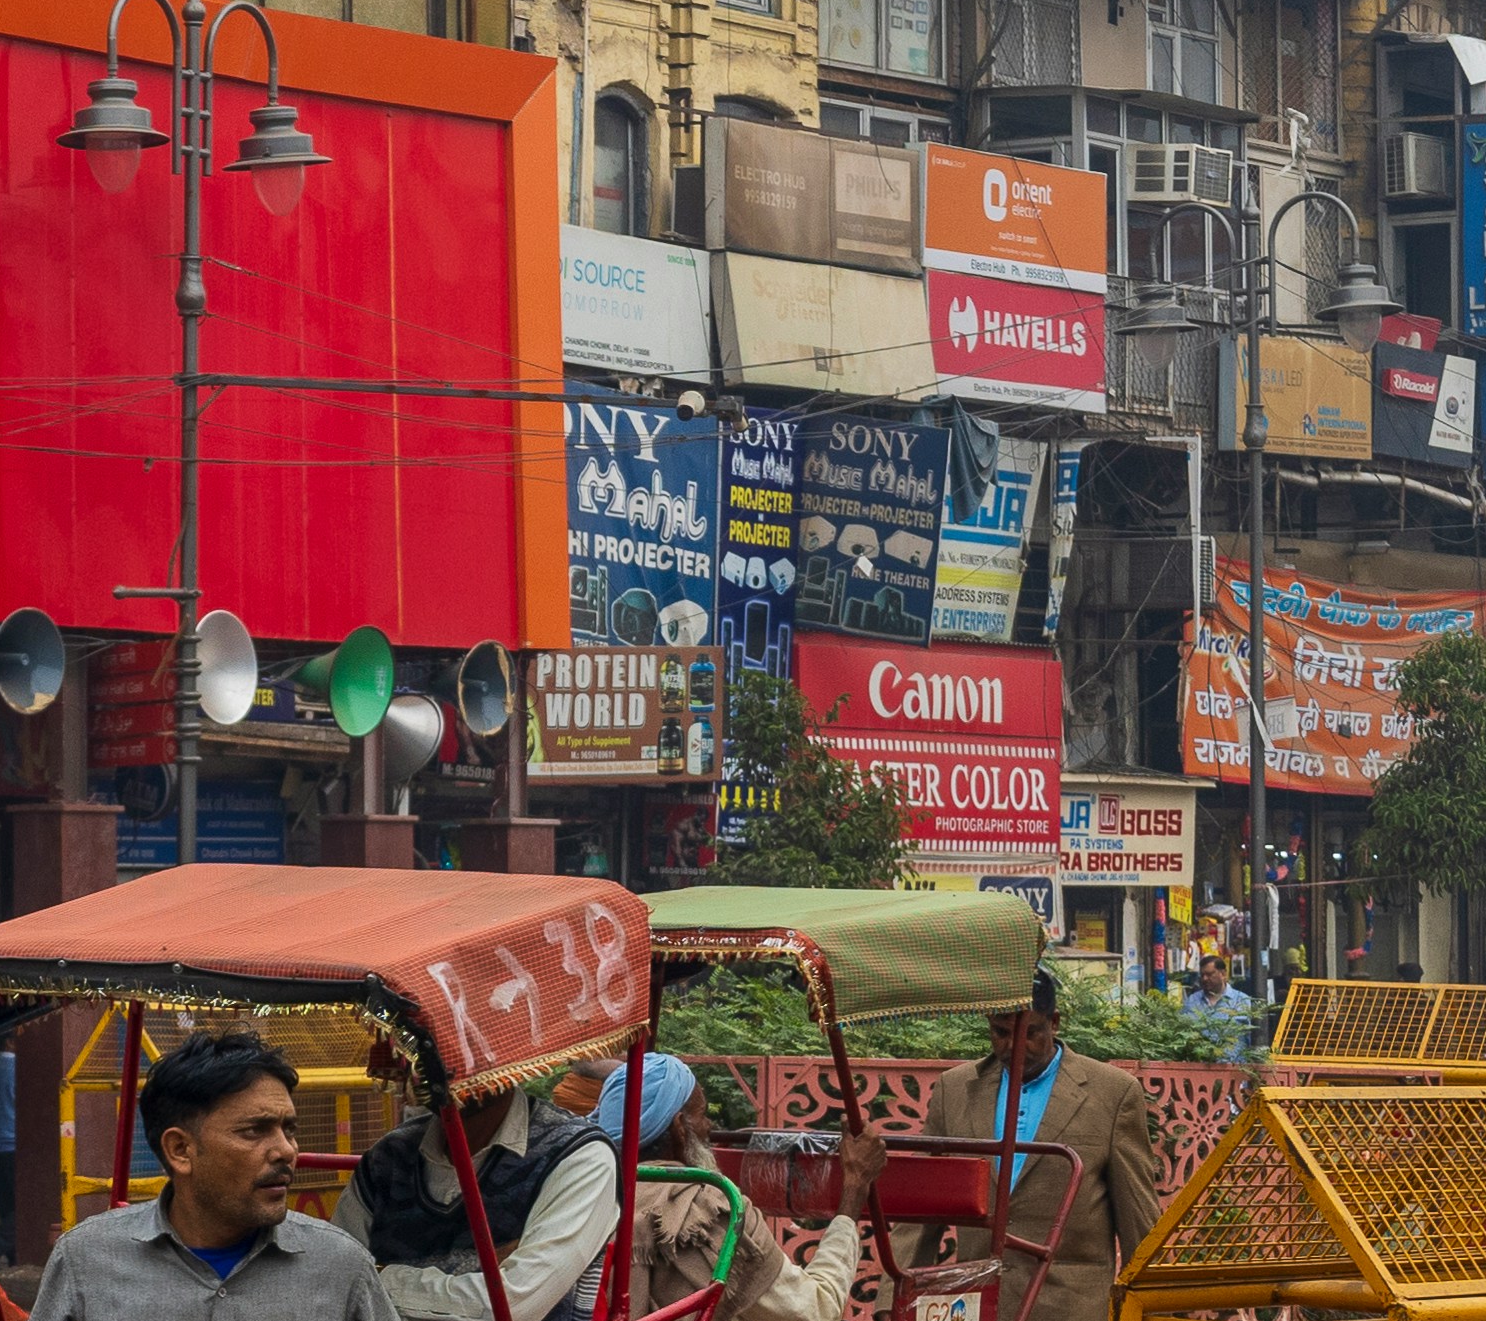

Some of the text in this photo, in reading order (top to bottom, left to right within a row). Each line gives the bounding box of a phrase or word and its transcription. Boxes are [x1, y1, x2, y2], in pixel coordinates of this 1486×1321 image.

[734, 164, 806, 191] ELECTRO HUB
[844, 172, 902, 202] PHILIPS
[1011, 179, 1053, 206] orient
[1011, 203, 1043, 221] electric
[573, 258, 646, 294] SOURCE
[971, 258, 993, 273] Electro
[993, 262, 1006, 275] Hub
[564, 291, 644, 321] OMORROW
[983, 309, 1087, 357] HAVELLS
[1402, 378, 1436, 395] Racold
[830, 421, 919, 462] SONY
[730, 484, 793, 514] PROJECTER
[870, 507, 934, 530] PROJECTER
[729, 520, 791, 548] PROJECTER
[594, 533, 711, 579] PROJECTER
[884, 569, 930, 590] THEATER
[935, 588, 1010, 606] ADDRESS SYSTEMS
[940, 609, 1007, 634] ENTERPRISES
[536, 652, 658, 691] PROTEIN
[868, 660, 1003, 725] Canon
[545, 692, 647, 730] WORLD
[950, 764, 1050, 812] COLOR
[935, 815, 1049, 835] PHOTOGRAPHIC STORE
[1120, 809, 1183, 836] BOSS
[1070, 837, 1124, 851] PA SYSTEMS
[1087, 852, 1183, 872] BROTHERS
